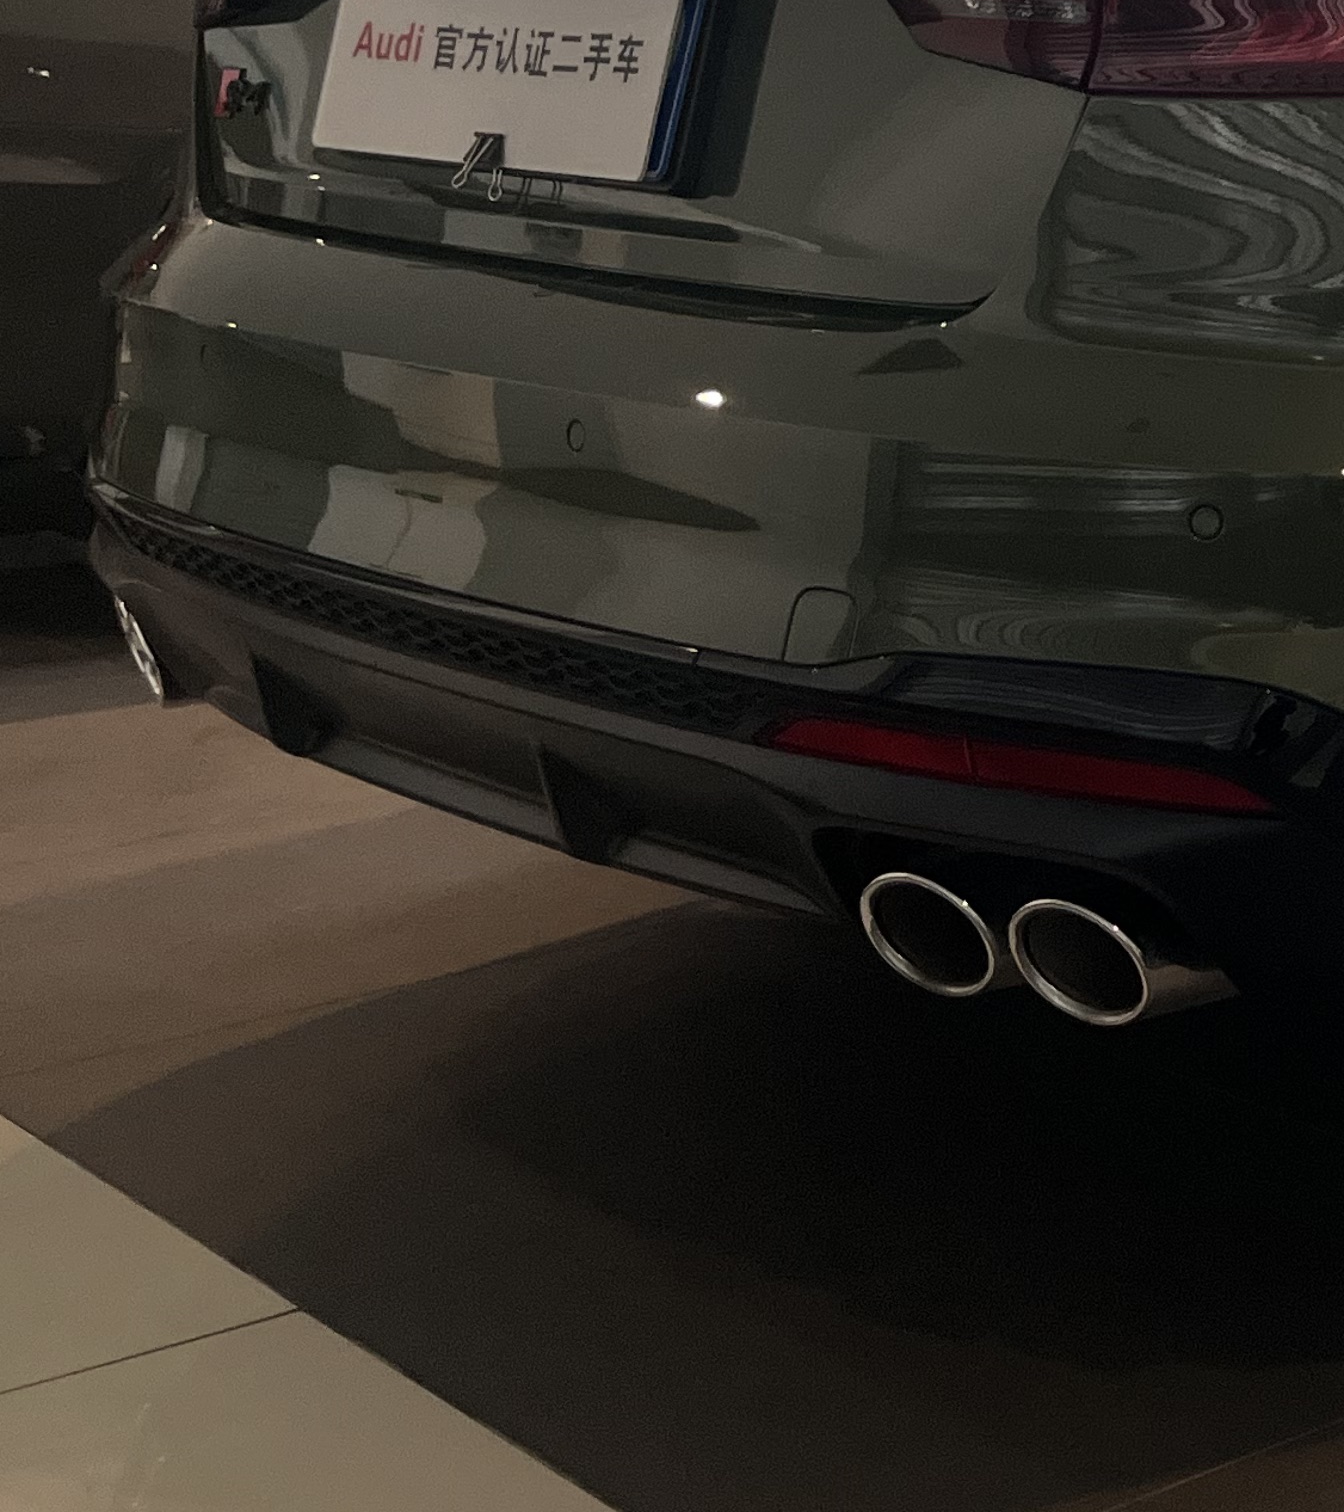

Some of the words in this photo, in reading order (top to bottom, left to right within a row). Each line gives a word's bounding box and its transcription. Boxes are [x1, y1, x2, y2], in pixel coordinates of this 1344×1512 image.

[352, 21, 425, 63] Audi
[433, 24, 644, 84] 官方认证二手车
